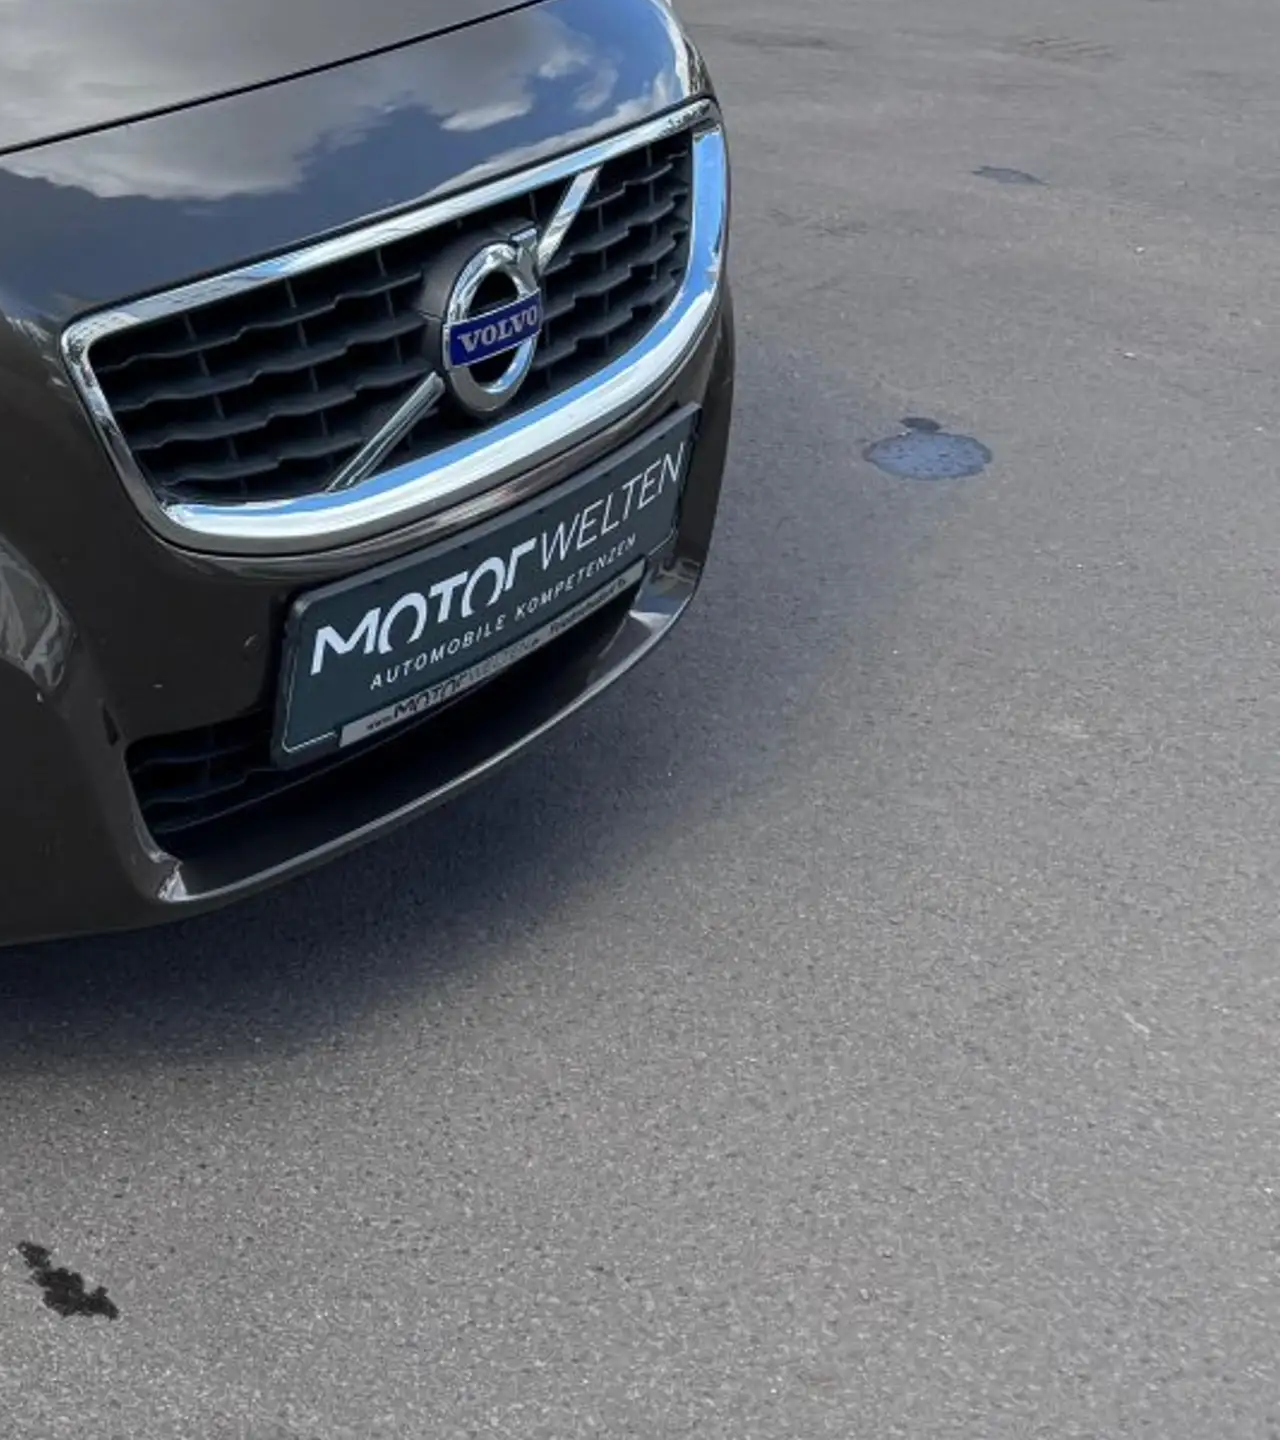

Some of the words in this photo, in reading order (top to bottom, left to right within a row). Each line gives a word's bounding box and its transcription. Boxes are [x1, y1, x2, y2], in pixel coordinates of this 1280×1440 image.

[457, 305, 537, 353] VOLVO
[369, 614, 506, 691] AUTOMOBILE
[515, 531, 637, 622] KOMPETENZEN
